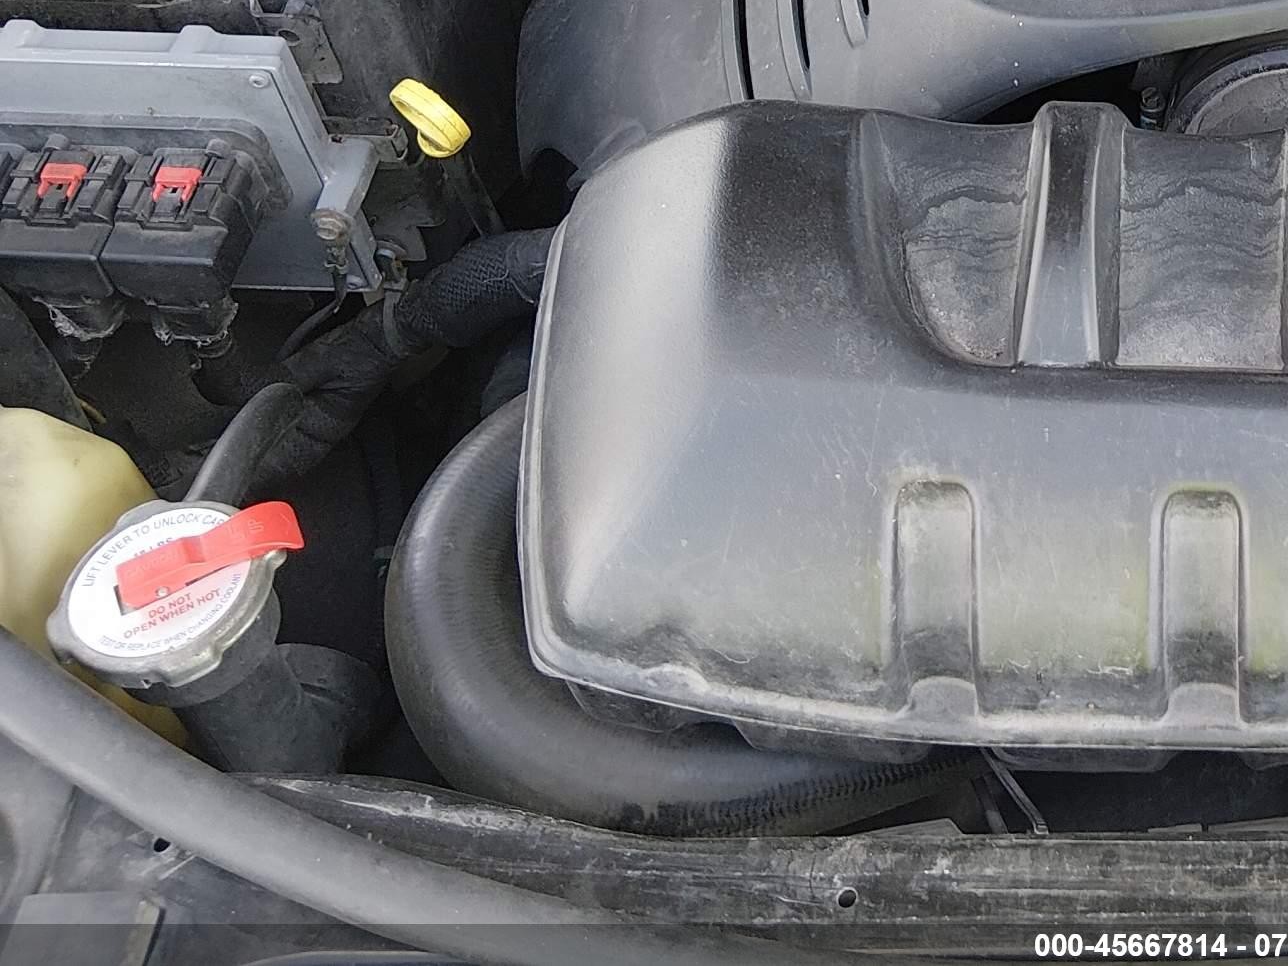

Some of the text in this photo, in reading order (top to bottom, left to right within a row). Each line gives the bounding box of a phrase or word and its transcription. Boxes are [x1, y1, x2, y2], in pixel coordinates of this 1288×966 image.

[81, 565, 101, 587] LIFT
[97, 535, 133, 566] LEVER
[133, 524, 151, 538] TO
[153, 512, 200, 530] UNLOCK
[123, 587, 222, 640] OPEN WHEN HOT
[148, 592, 192, 619] DO NOT
